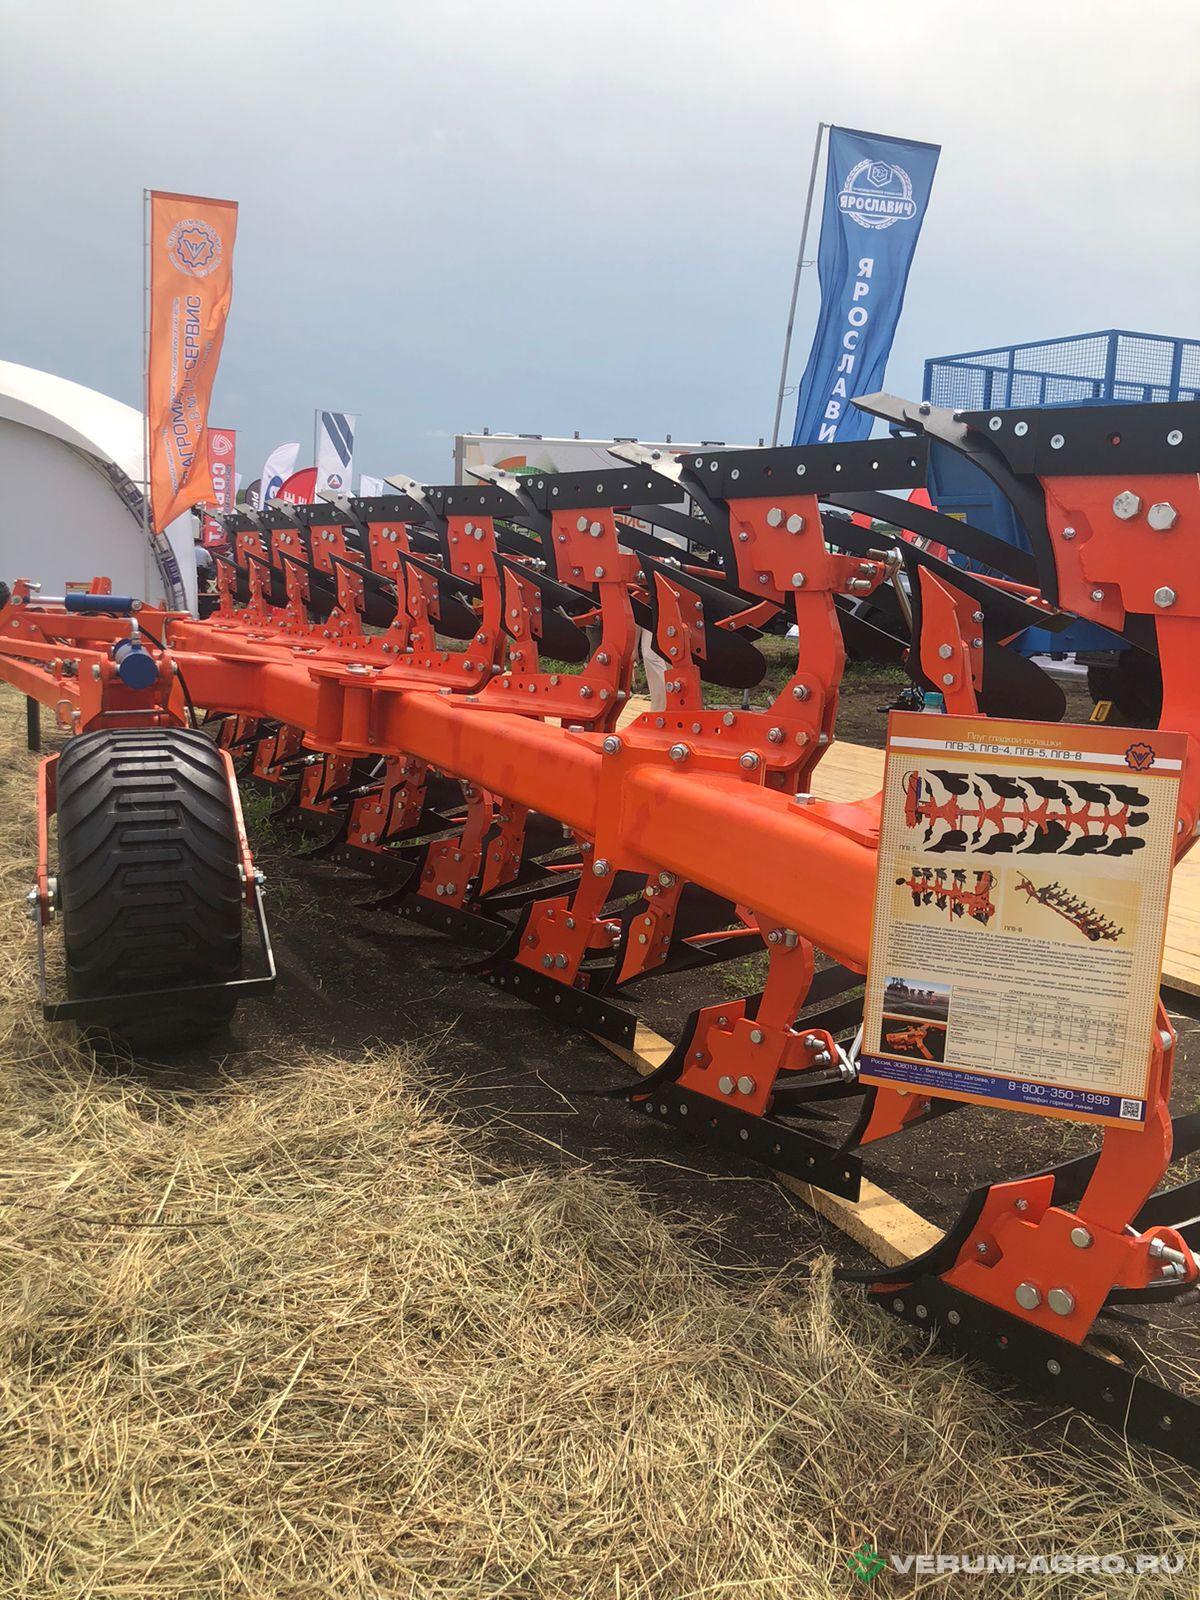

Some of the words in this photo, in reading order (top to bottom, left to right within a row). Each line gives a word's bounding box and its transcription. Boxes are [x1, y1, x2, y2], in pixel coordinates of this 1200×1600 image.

[840, 195, 913, 215] ЯРОСЛАВИЧ
[967, 731, 987, 742] Плуг
[945, 741, 977, 752] ПГВ-3,
[979, 744, 1012, 756] ПГВ-4,
[1015, 747, 1048, 758] ПГВ-5,
[1050, 749, 1082, 760] ПГВ-8
[1008, 1081, 1111, 1106] 8-800-350-1998
